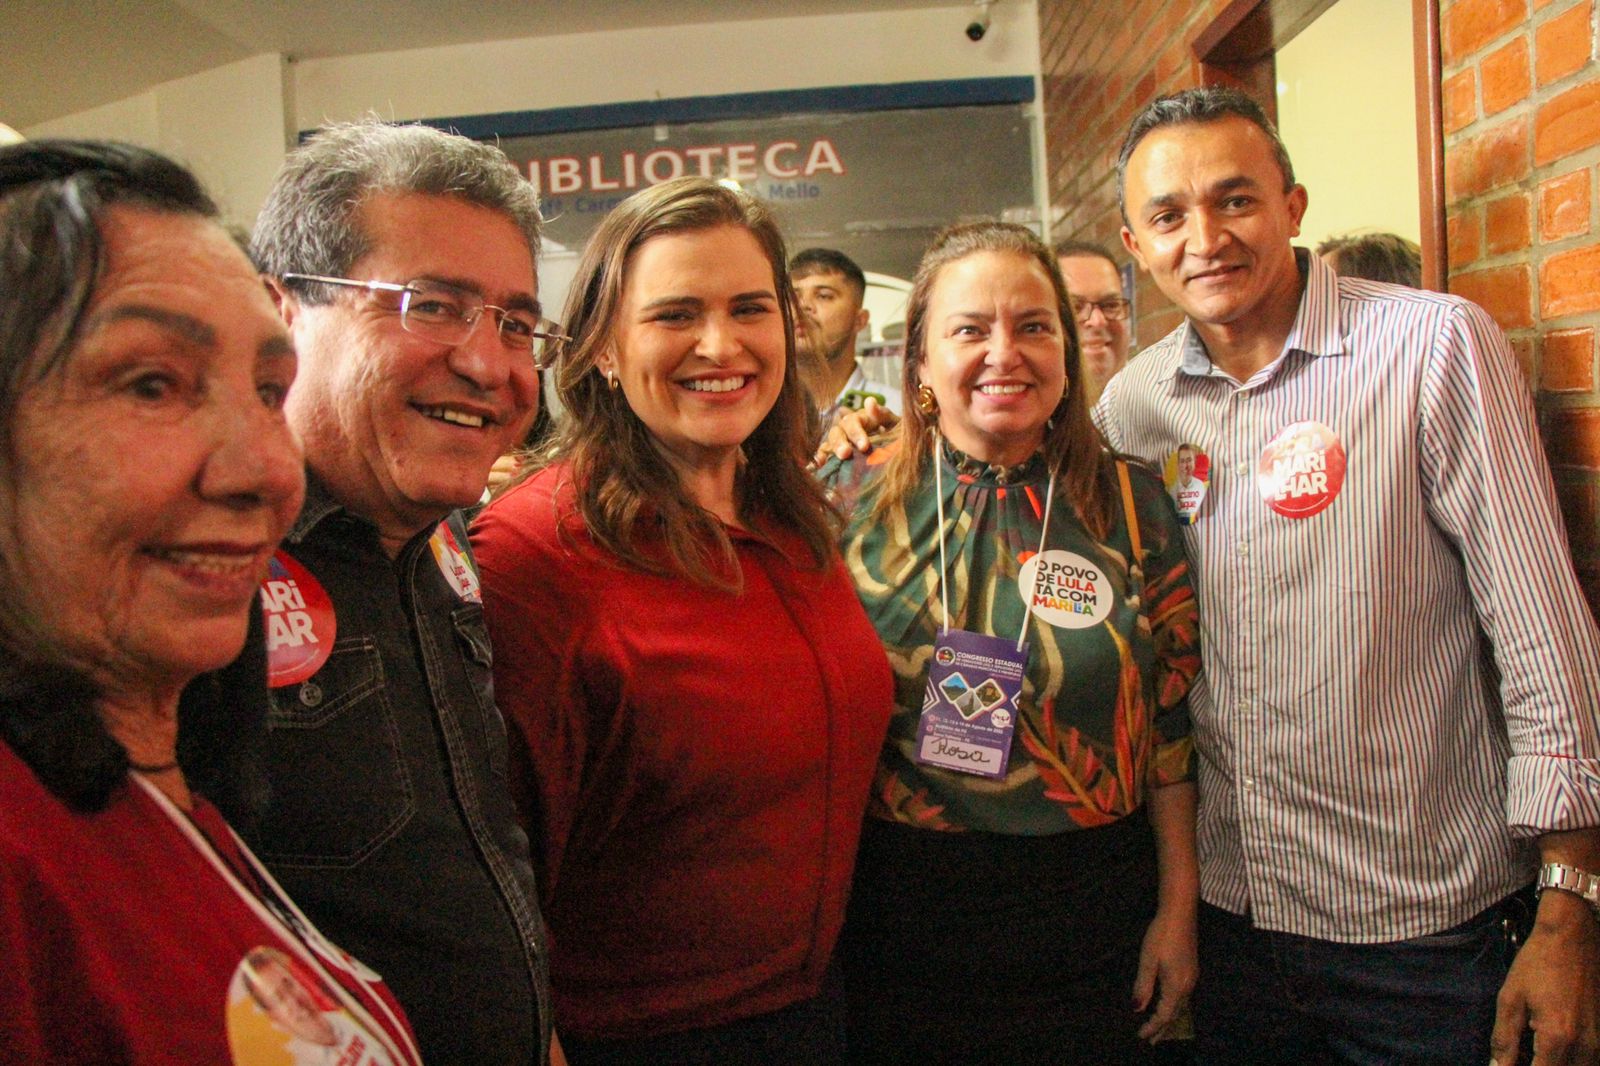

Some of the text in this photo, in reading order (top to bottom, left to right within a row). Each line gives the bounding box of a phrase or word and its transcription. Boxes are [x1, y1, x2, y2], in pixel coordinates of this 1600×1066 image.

[526, 139, 845, 195] IBLIOTECA
[1052, 563, 1098, 581] POVO
[1057, 576, 1096, 593] LULA
[1057, 588, 1097, 606] COM
[956, 651, 994, 664] CONGRESSO
[994, 658, 1023, 670] ESTADUAL
[931, 738, 990, 763] Rosa
